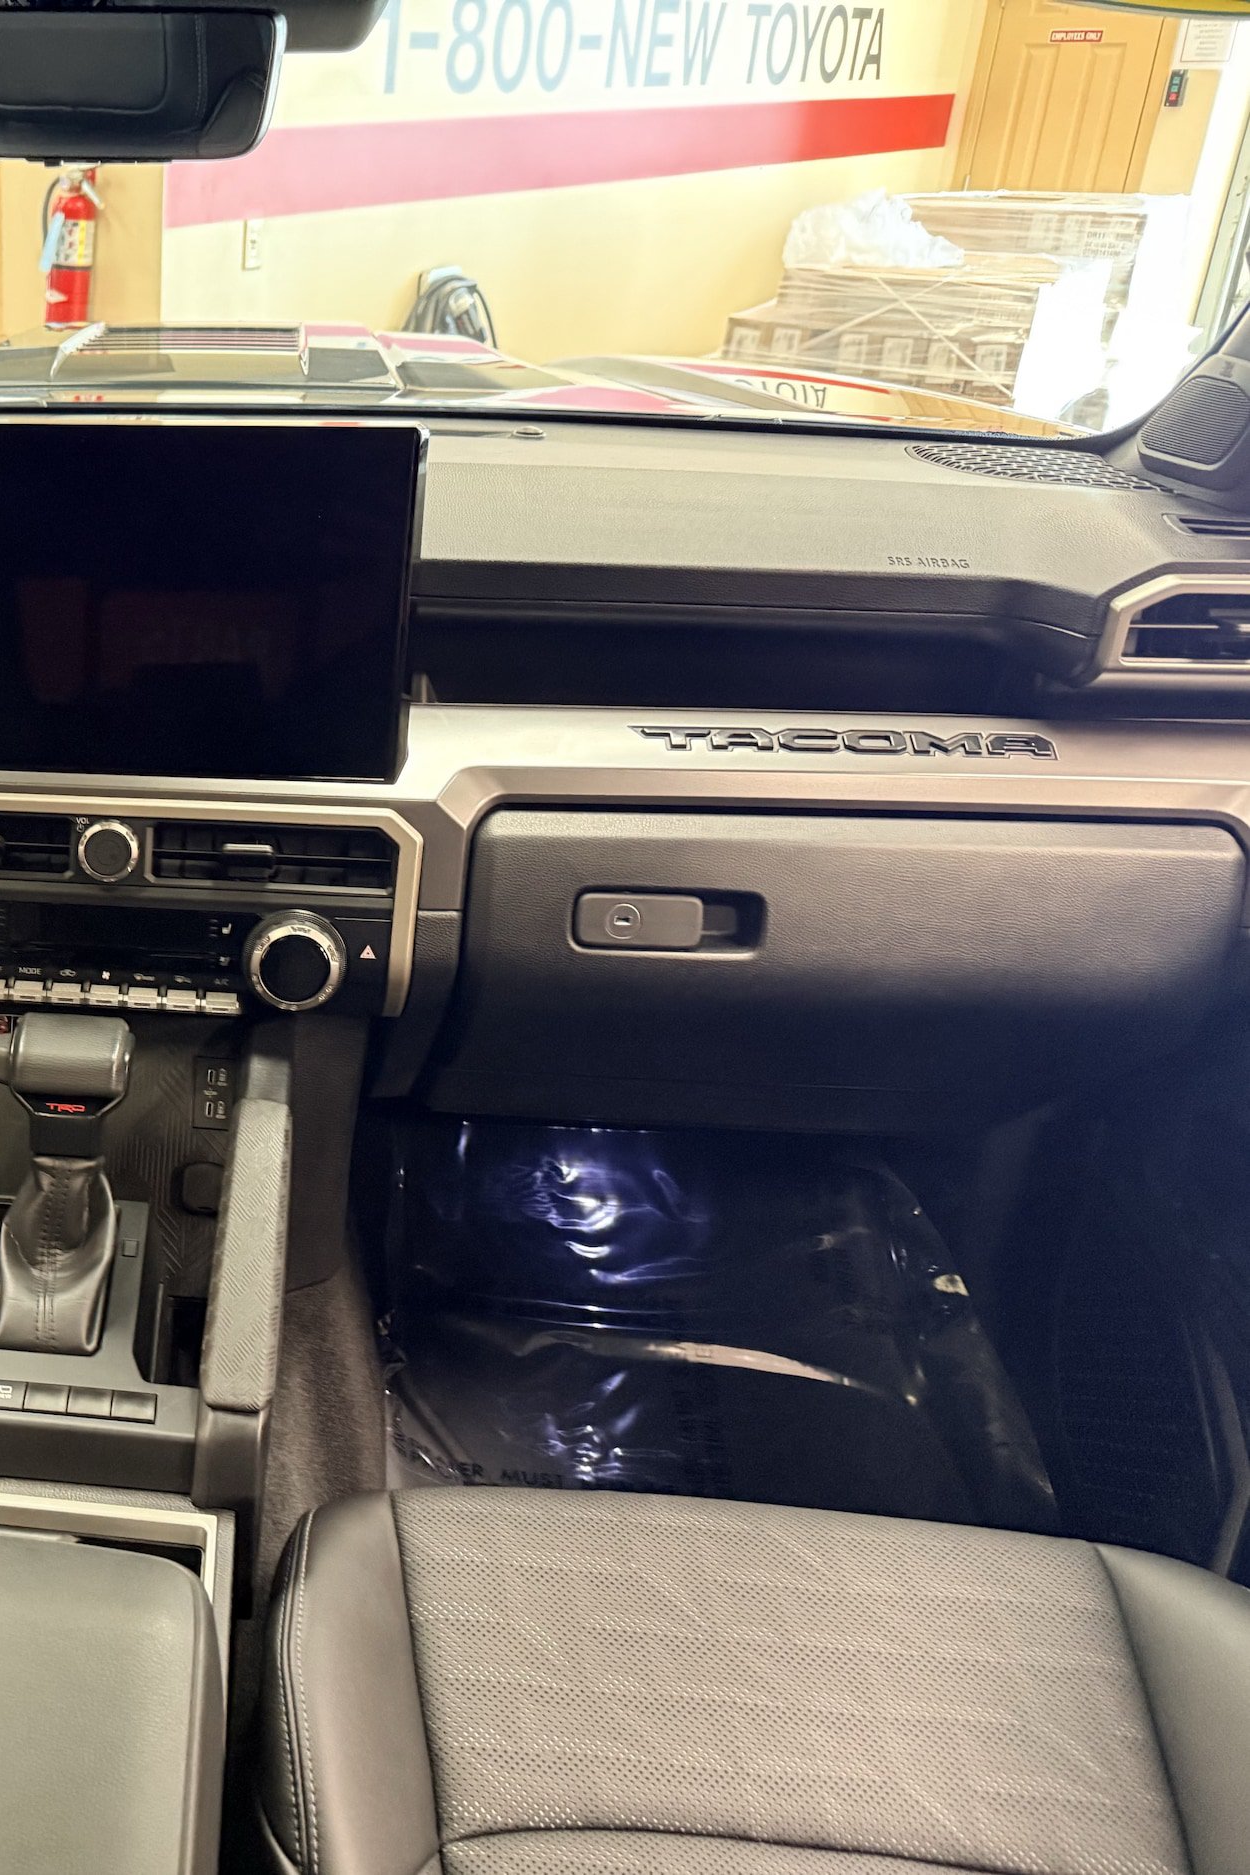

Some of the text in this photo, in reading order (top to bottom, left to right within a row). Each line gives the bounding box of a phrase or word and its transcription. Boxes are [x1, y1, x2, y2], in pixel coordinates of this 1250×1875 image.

[1051, 31, 1102, 41] EMPLOYEES ONLY
[381, 0, 885, 94] 1-800-NEW TOYOTA
[887, 556, 970, 569] SRS AIRBAG
[628, 724, 1060, 761] TACOMA
[75, 817, 90, 825] VOL
[18, 966, 43, 975] MODE
[45, 1102, 86, 1113] TRD
